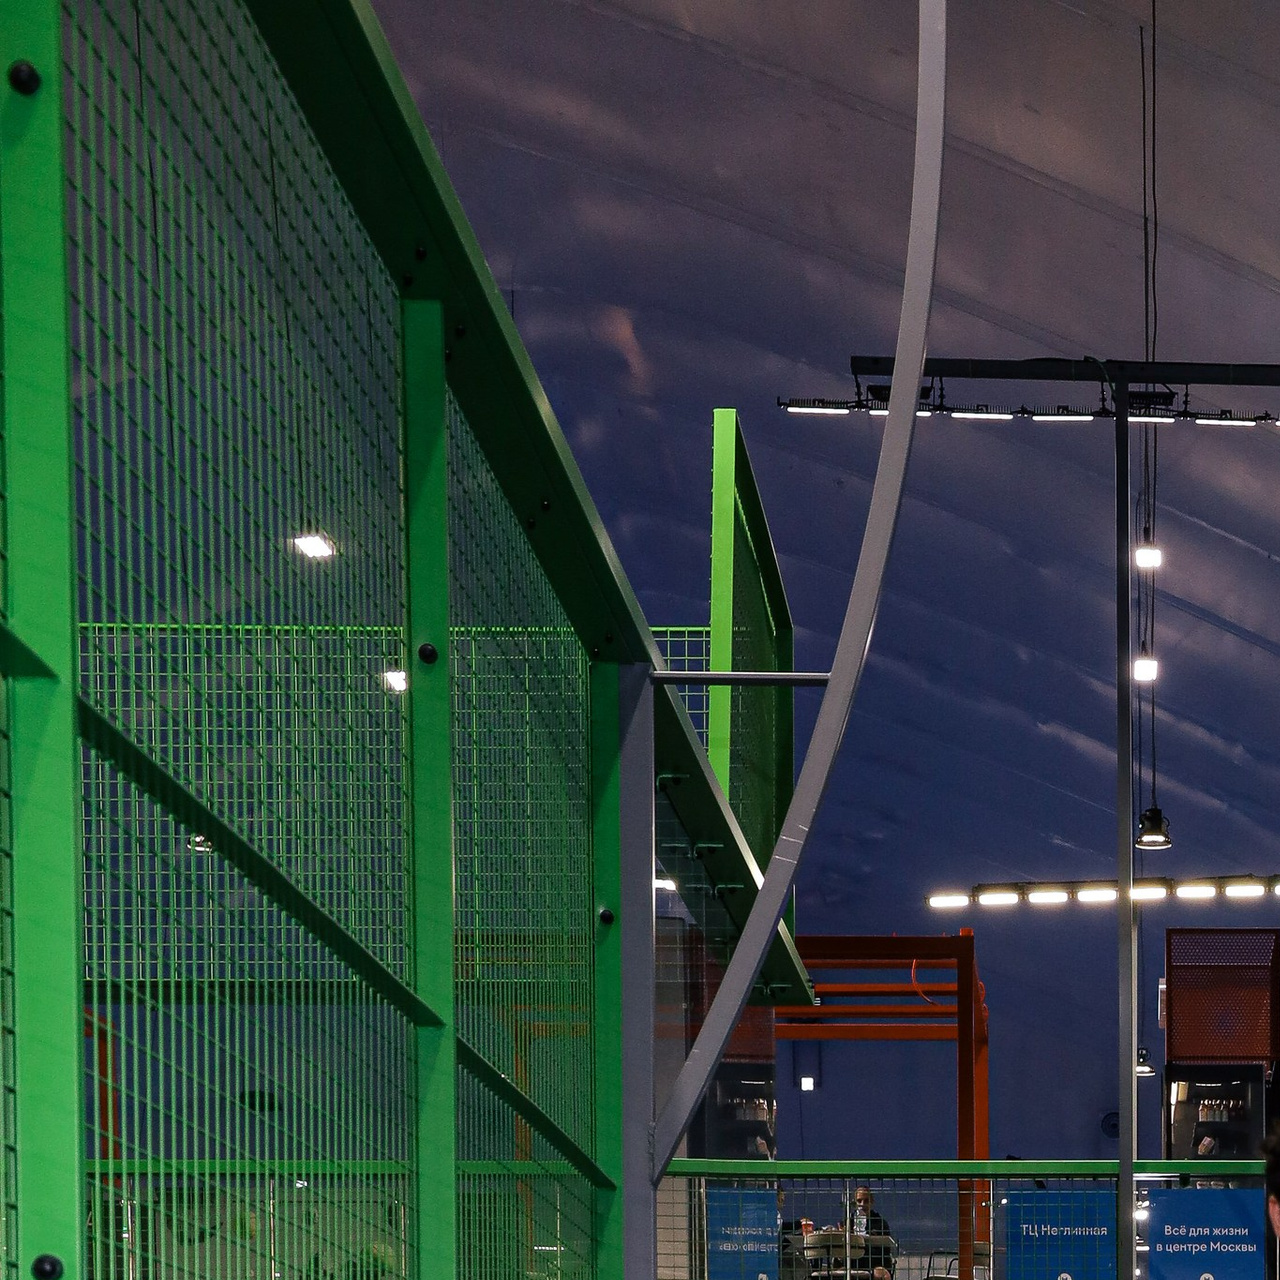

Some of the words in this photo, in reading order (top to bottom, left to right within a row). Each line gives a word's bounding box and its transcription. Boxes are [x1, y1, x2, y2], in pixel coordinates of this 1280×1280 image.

[1020, 1224, 1039, 1238] ТЦ
[1041, 1224, 1108, 1236] Неглинная
[1164, 1223, 1187, 1236] Всё
[1188, 1226, 1210, 1238] для
[1212, 1226, 1249, 1236] жизни
[1156, 1243, 1164, 1252] в
[1165, 1242, 1207, 1255] центре
[1210, 1241, 1257, 1252] Москвы
